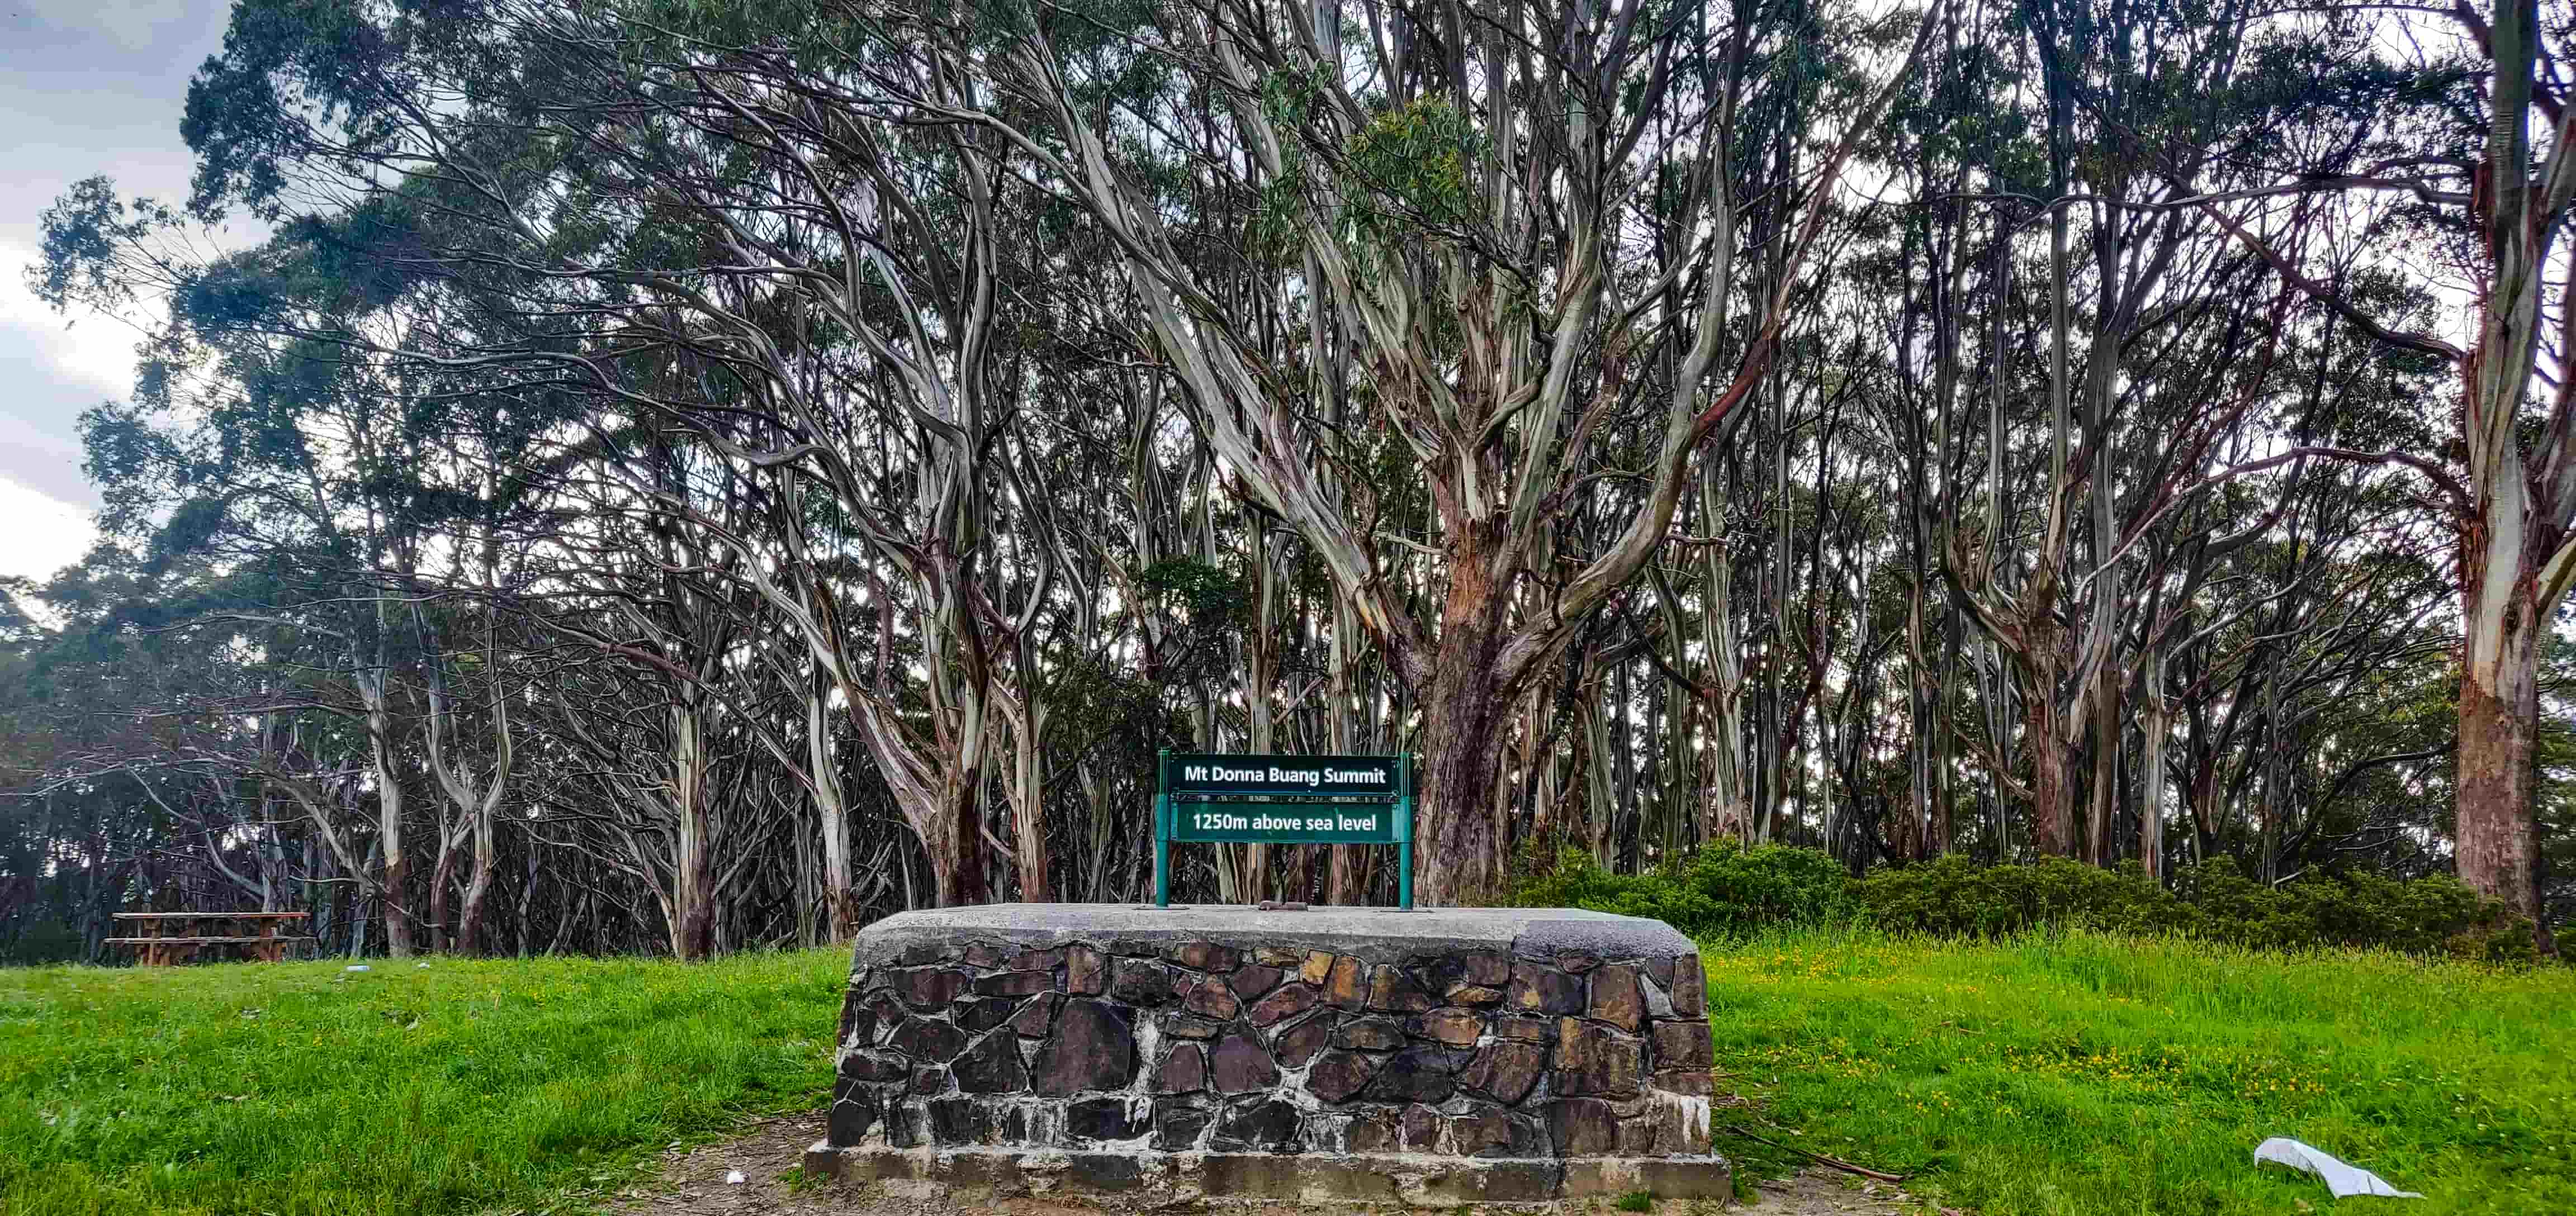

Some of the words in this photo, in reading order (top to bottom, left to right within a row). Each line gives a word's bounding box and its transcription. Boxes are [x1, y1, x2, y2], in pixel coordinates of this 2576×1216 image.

[1185, 766, 1208, 782] Mt
[1212, 766, 1265, 782] Donna
[1269, 767, 1319, 787] Buang
[1324, 767, 1386, 783] Summit
[1193, 814, 1247, 830] 1250m
[1252, 814, 1302, 831] above
[1306, 818, 1333, 831] sea
[1338, 814, 1376, 832] level
